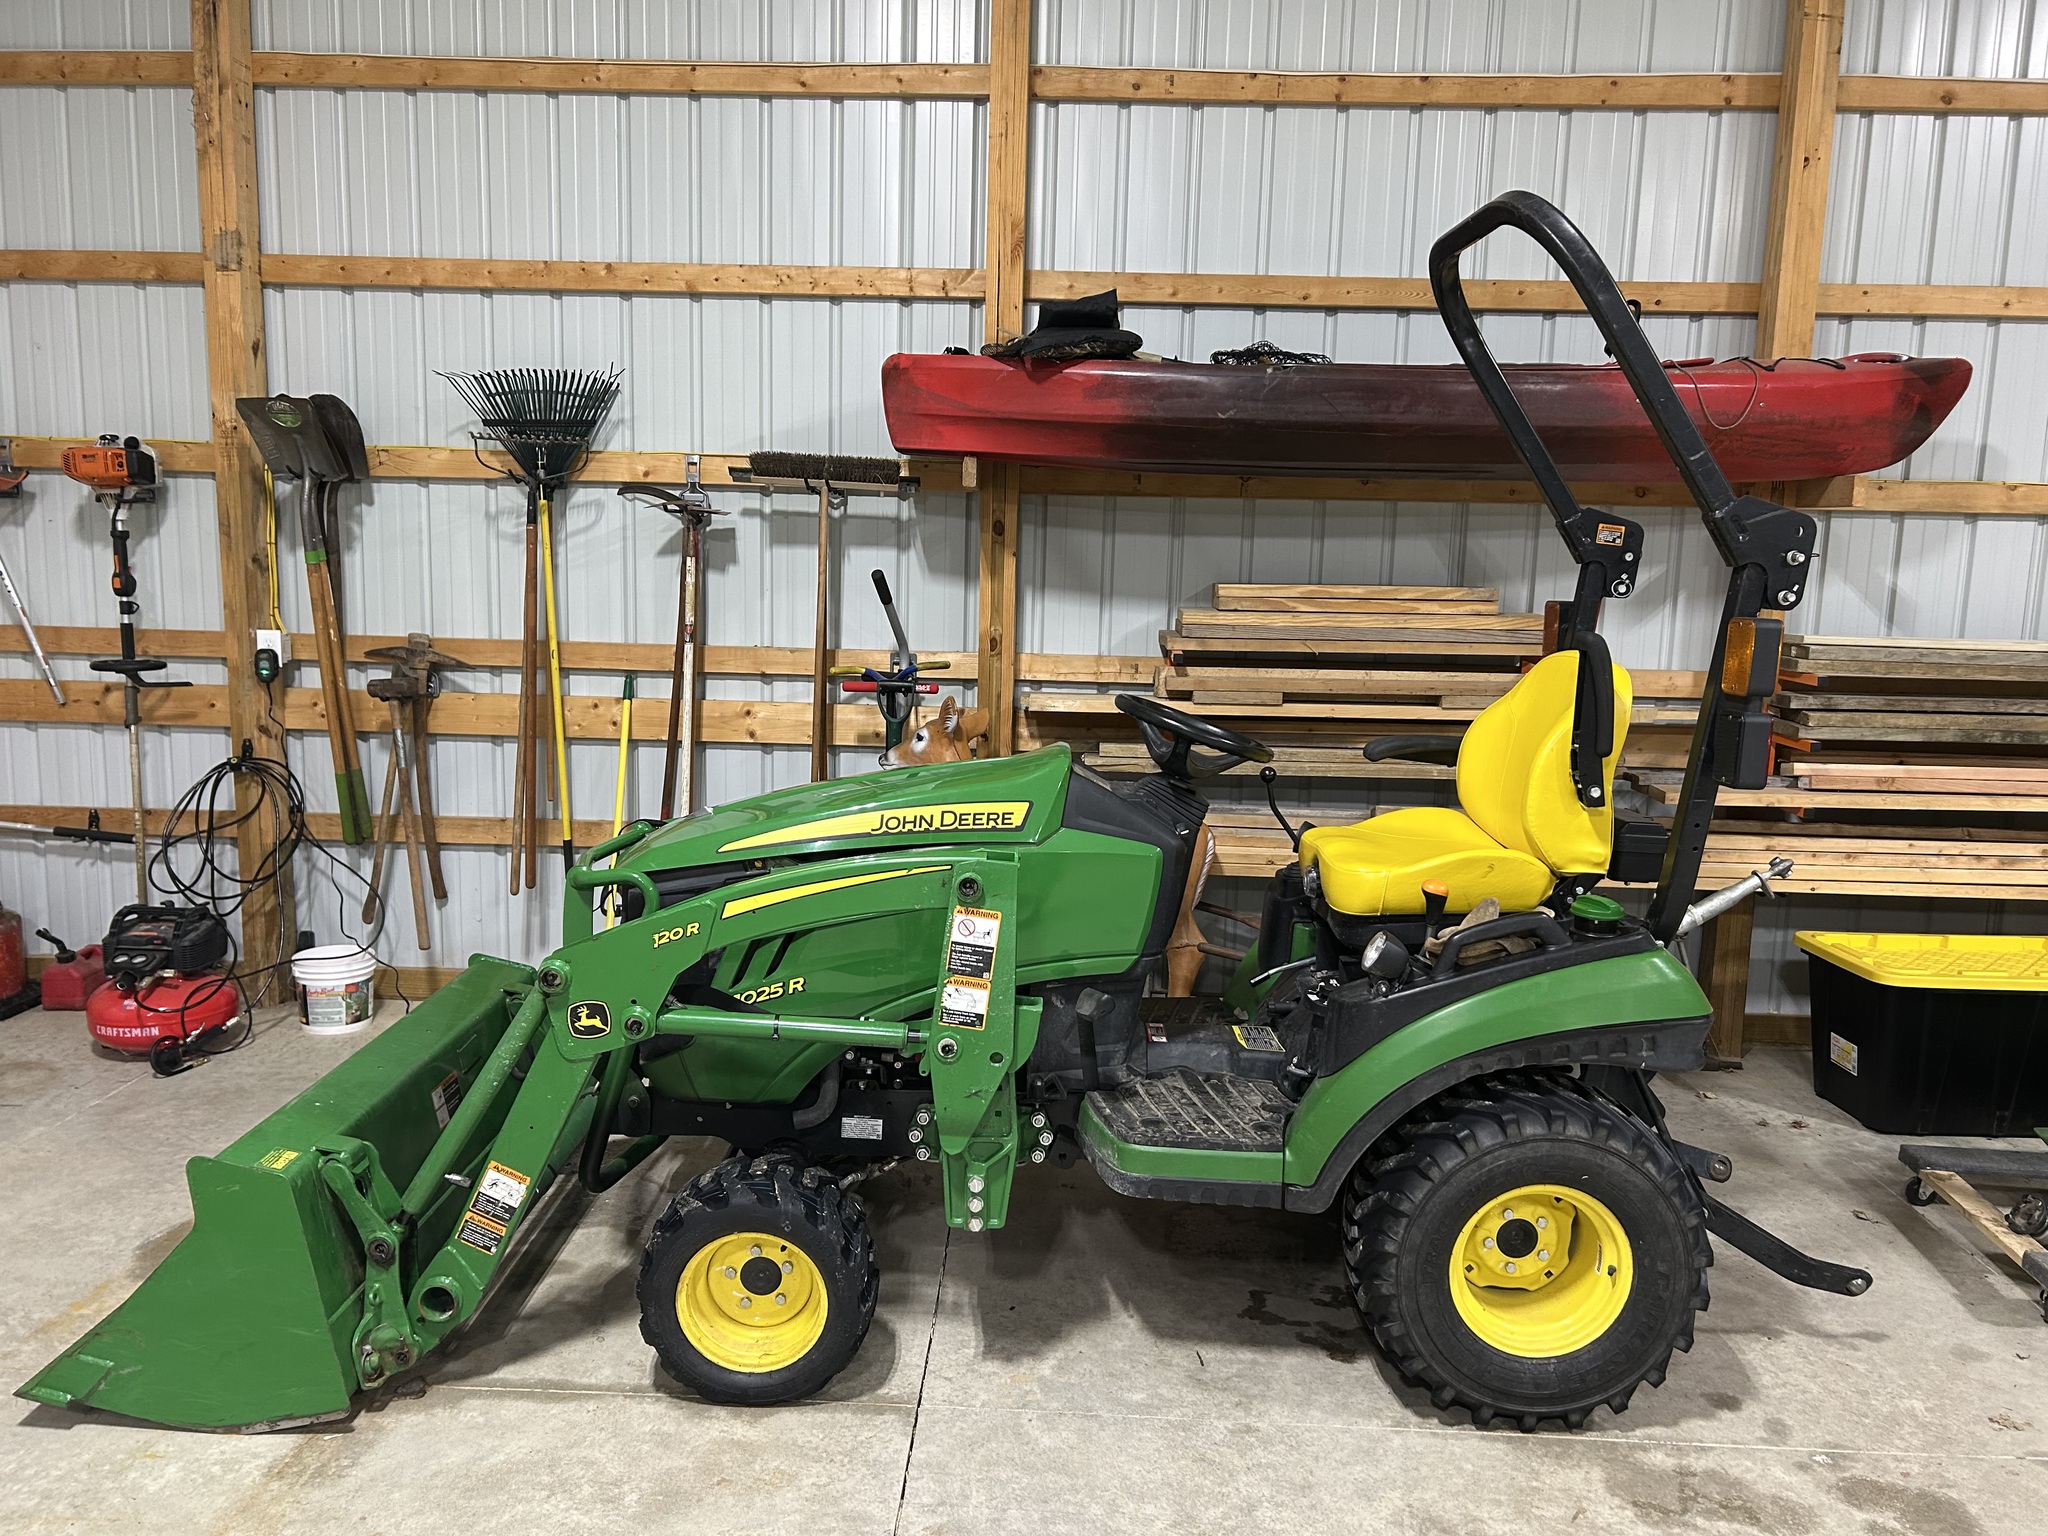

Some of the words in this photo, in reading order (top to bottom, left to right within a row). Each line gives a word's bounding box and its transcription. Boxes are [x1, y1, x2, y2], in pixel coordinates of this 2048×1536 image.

[871, 814, 934, 832] JOHN
[940, 811, 1014, 828] DEERE
[963, 908, 999, 920] WARNING
[652, 927, 684, 949] 120
[686, 922, 700, 937] R
[788, 977, 806, 995] R
[953, 979, 988, 990] WARNING
[96, 1025, 160, 1038] CRAFTSMAN
[500, 1166, 528, 1184] WARNING
[477, 1219, 504, 1235] WARNING
